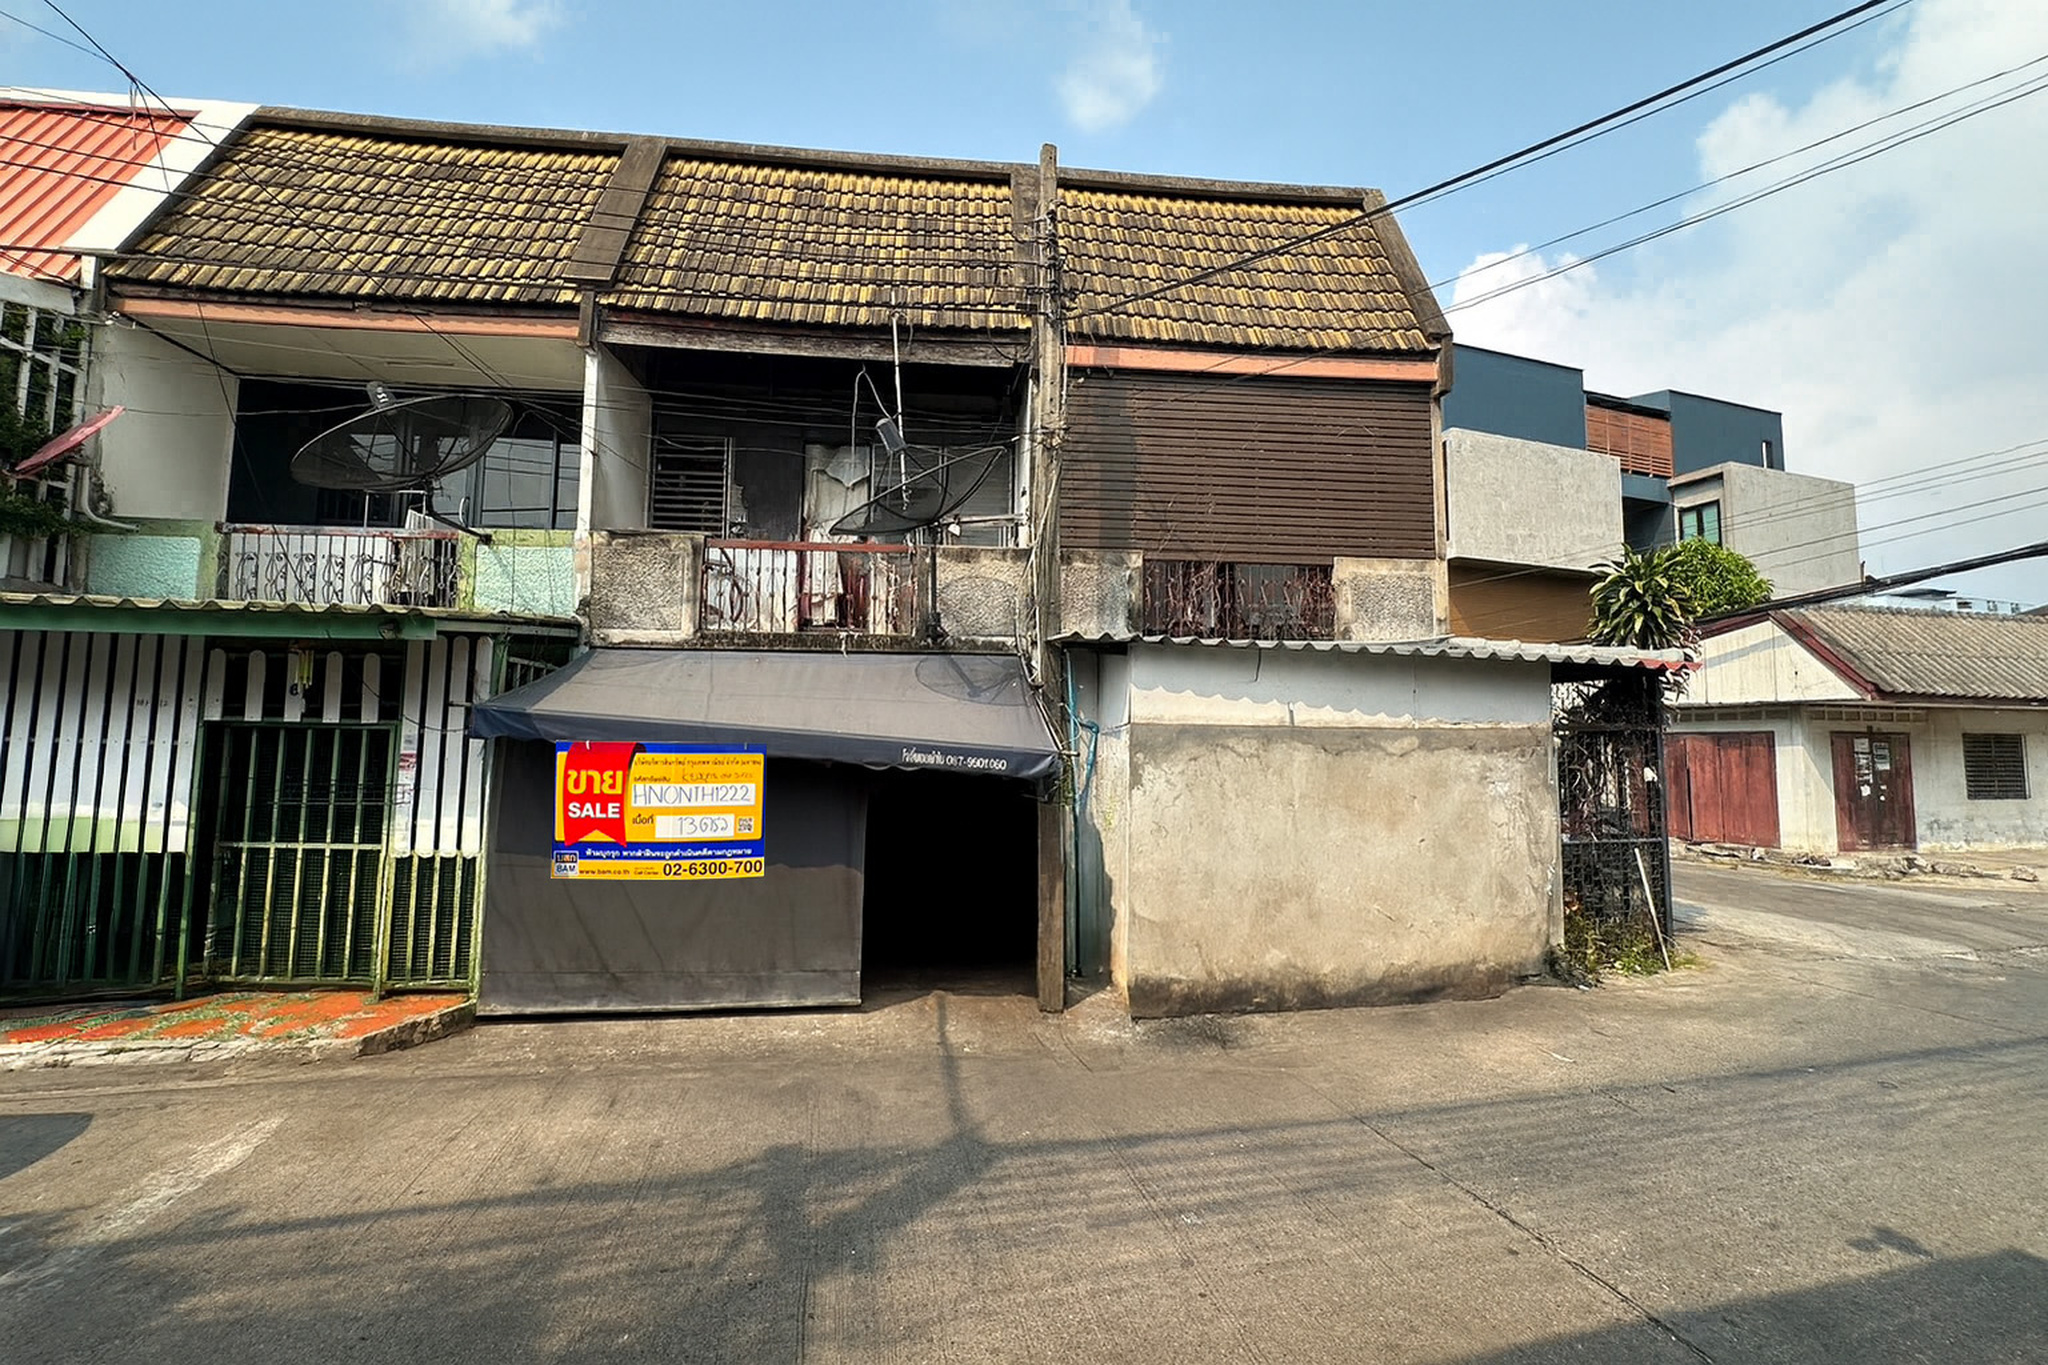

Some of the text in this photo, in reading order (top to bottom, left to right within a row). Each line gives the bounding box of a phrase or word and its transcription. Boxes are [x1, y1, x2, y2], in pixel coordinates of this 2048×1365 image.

[567, 769, 623, 794] ขาย
[567, 802, 621, 818] SALE
[678, 816, 698, 835] 13
[556, 864, 576, 873] BAM
[663, 860, 763, 876] 02-6300-700
